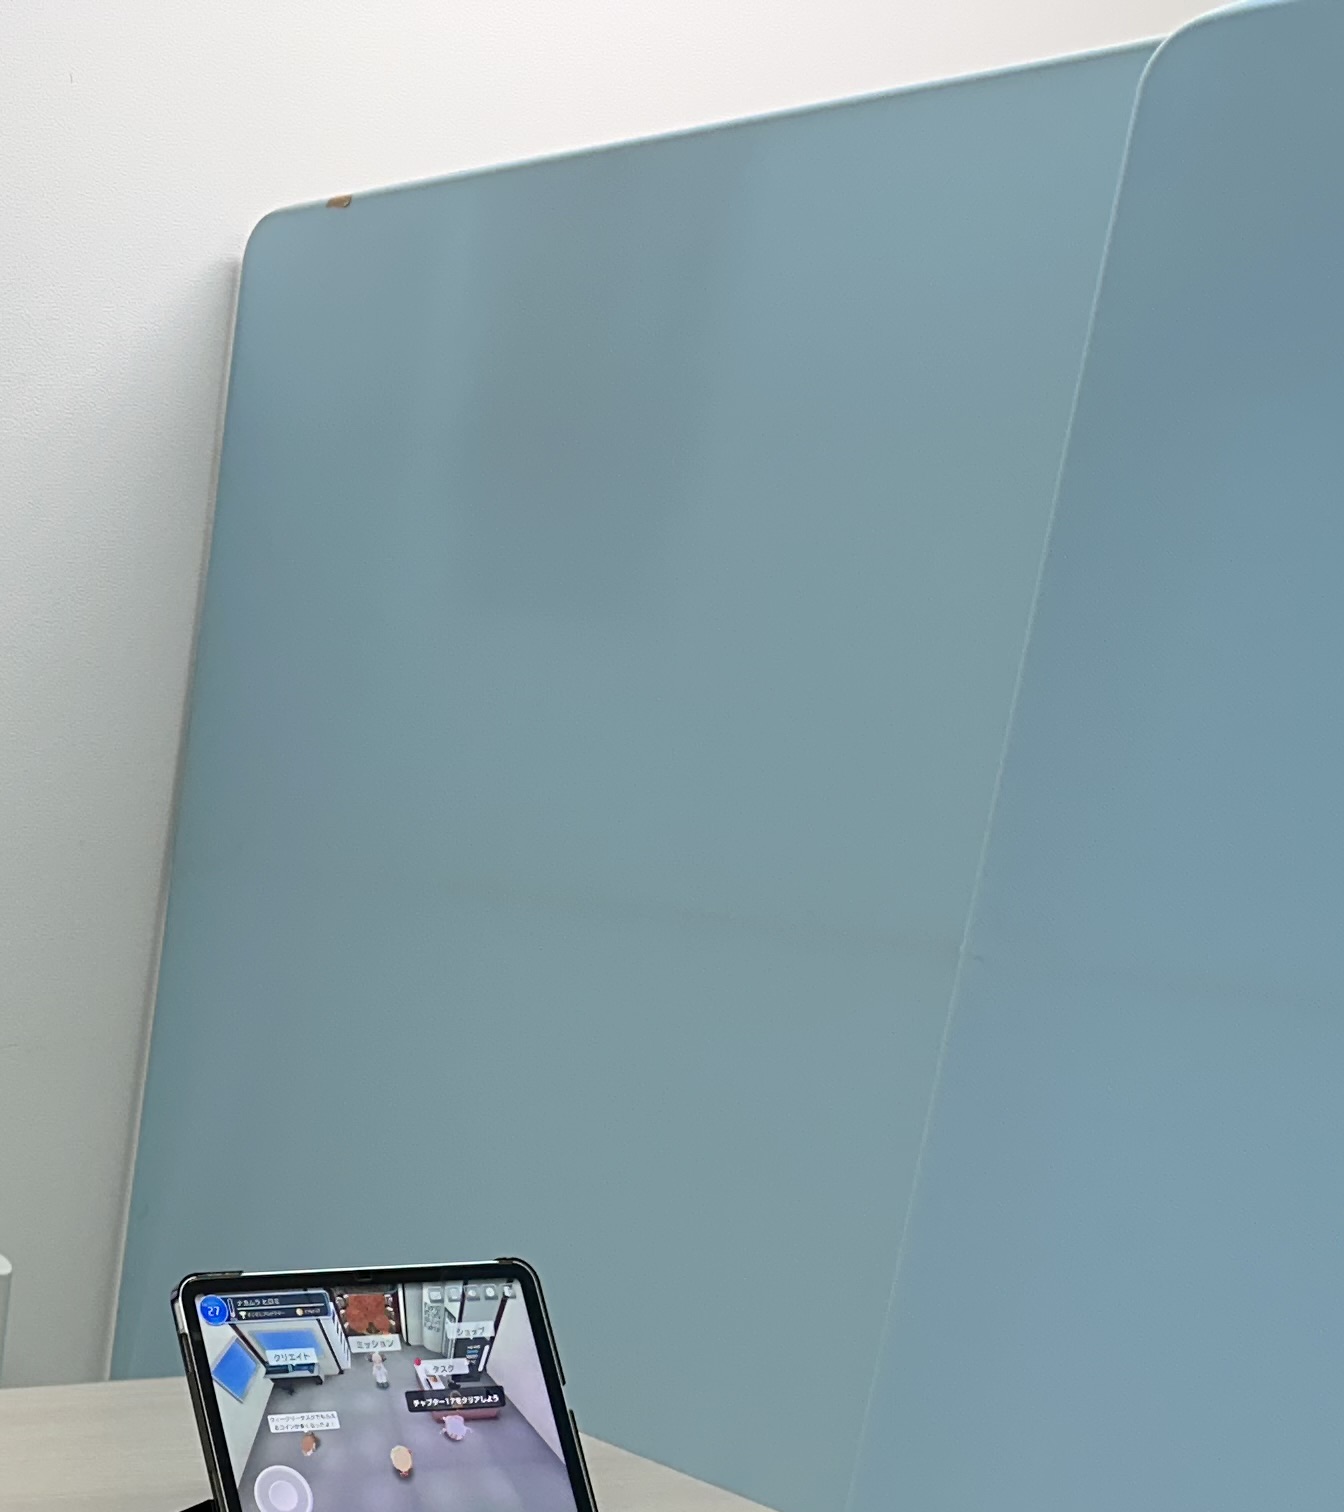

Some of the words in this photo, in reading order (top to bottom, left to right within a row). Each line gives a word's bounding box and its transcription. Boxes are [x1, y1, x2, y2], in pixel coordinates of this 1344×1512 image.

[207, 1305, 220, 1317] 27
[456, 1326, 486, 1337] ショップ
[356, 1338, 395, 1350] ミッション
[273, 1352, 310, 1363] クリエイト
[432, 1364, 454, 1373] タスク
